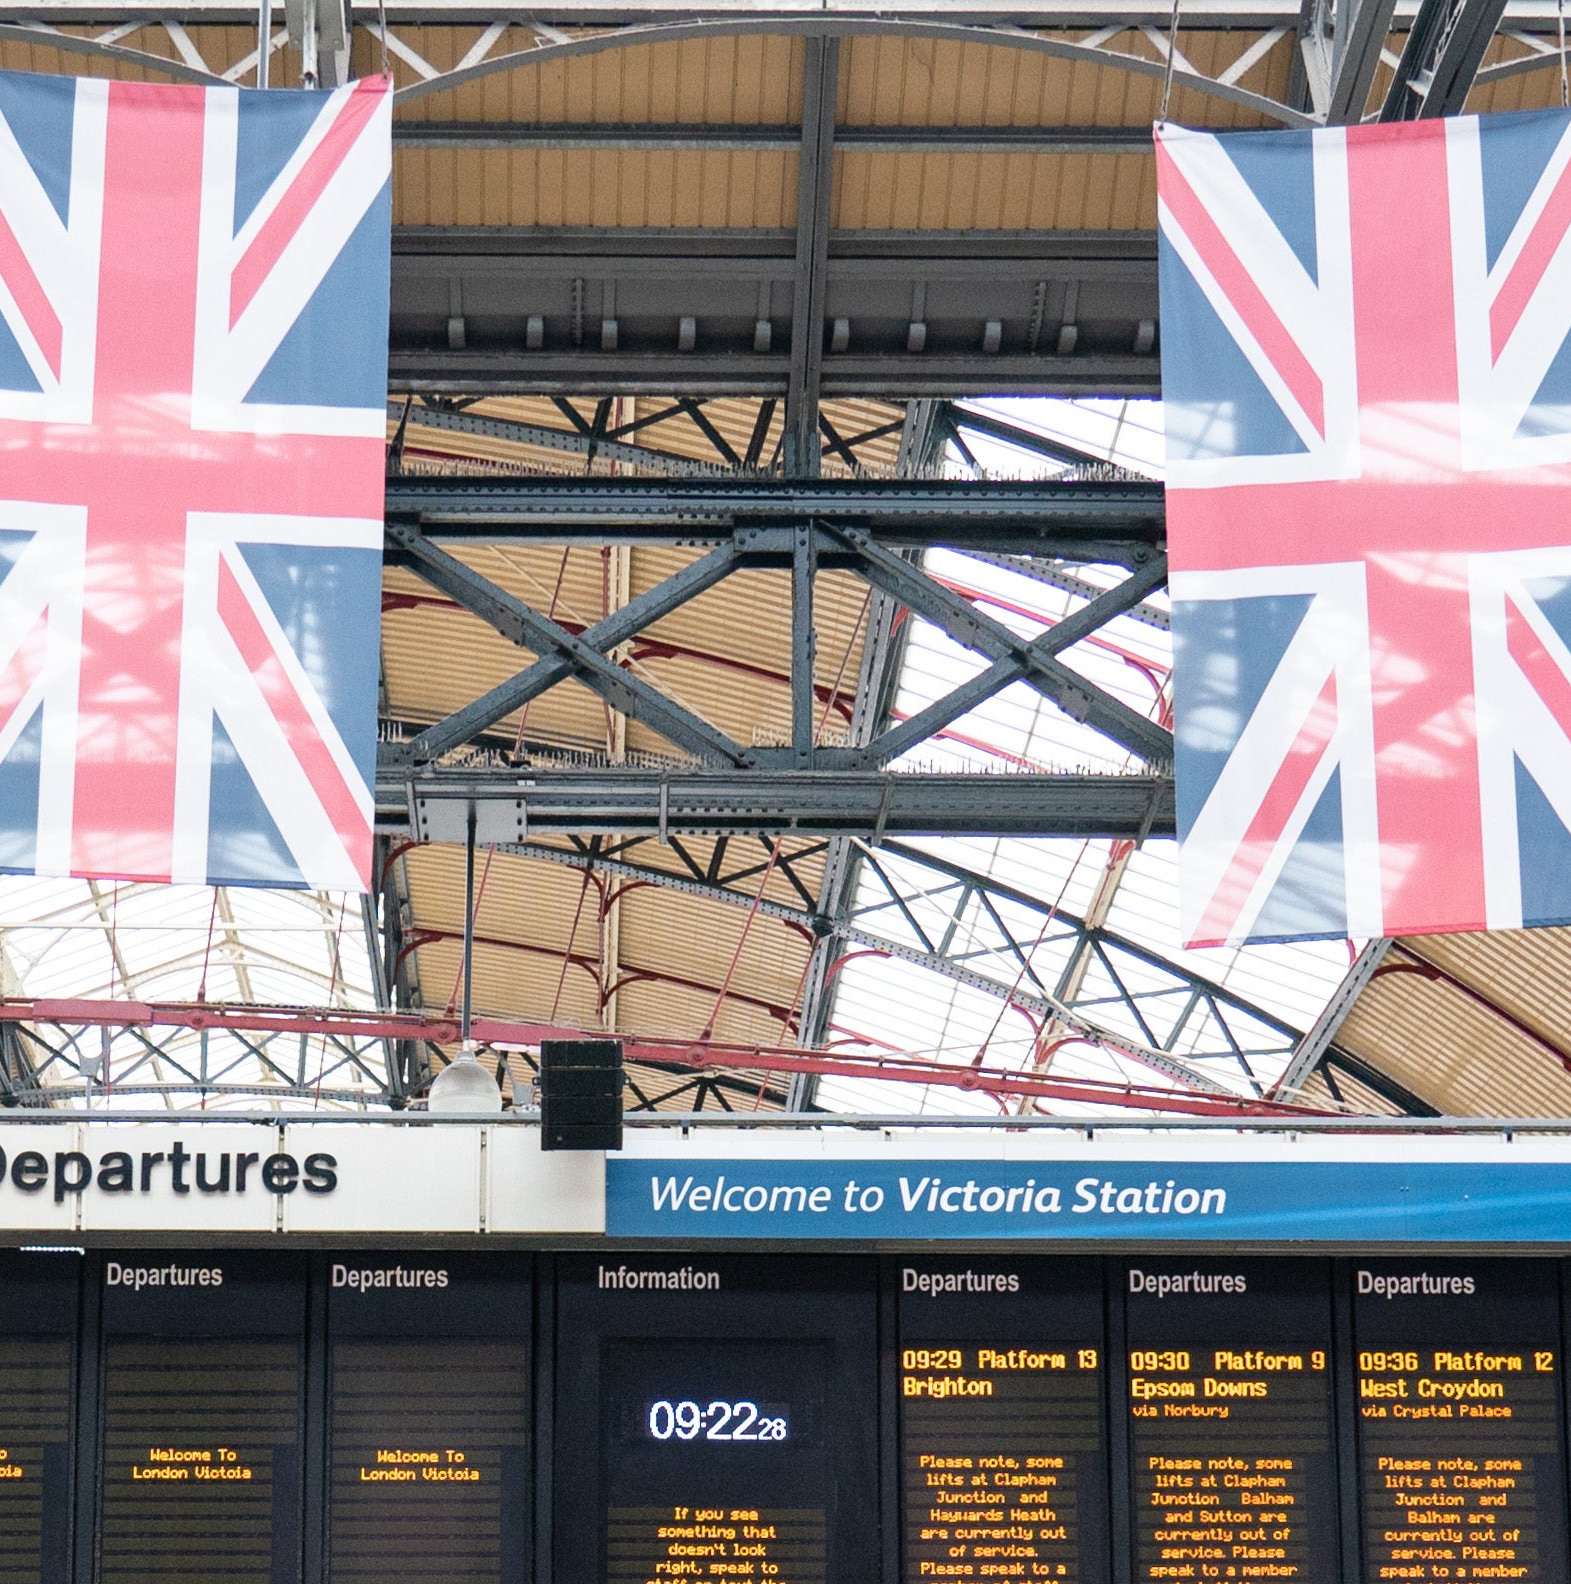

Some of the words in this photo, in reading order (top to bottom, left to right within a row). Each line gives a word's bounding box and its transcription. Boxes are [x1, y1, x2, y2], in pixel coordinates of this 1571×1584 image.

[652, 1176, 831, 1211] Welcome
[845, 1181, 883, 1211] to
[899, 1178, 1061, 1212] Victoria
[1072, 1178, 1226, 1213] Station
[599, 1266, 719, 1289] Information
[1130, 1270, 1246, 1297] Departures
[902, 1349, 962, 1370] 09:29
[978, 1349, 1066, 1369] Platform
[1077, 1349, 1097, 1369] 13
[1130, 1351, 1190, 1371] 09:30
[1214, 1351, 1303, 1371] Platform
[1310, 1350, 1326, 1370] 9
[1359, 1351, 1419, 1372] 09:36
[1434, 1351, 1522, 1372] Platform
[1533, 1351, 1554, 1372] 12
[903, 1376, 993, 1399] Brighton
[1131, 1377, 1196, 1401] Epsom
[1203, 1377, 1268, 1398] Downs
[1360, 1378, 1409, 1398] West
[1417, 1378, 1504, 1401] Croydon
[1361, 1404, 1387, 1418] via
[1392, 1404, 1454, 1419] Crystal
[1459, 1404, 1512, 1418] Palace
[674, 1506, 690, 1521] If
[694, 1509, 725, 1522] you
[729, 1509, 760, 1522] see
[657, 1524, 737, 1541] something
[741, 1525, 777, 1540] that
[667, 1542, 728, 1557] doesn't
[732, 1542, 767, 1557] look
[655, 1559, 703, 1576] right,
[708, 1560, 755, 1576] speak
[760, 1560, 779, 1575] to
